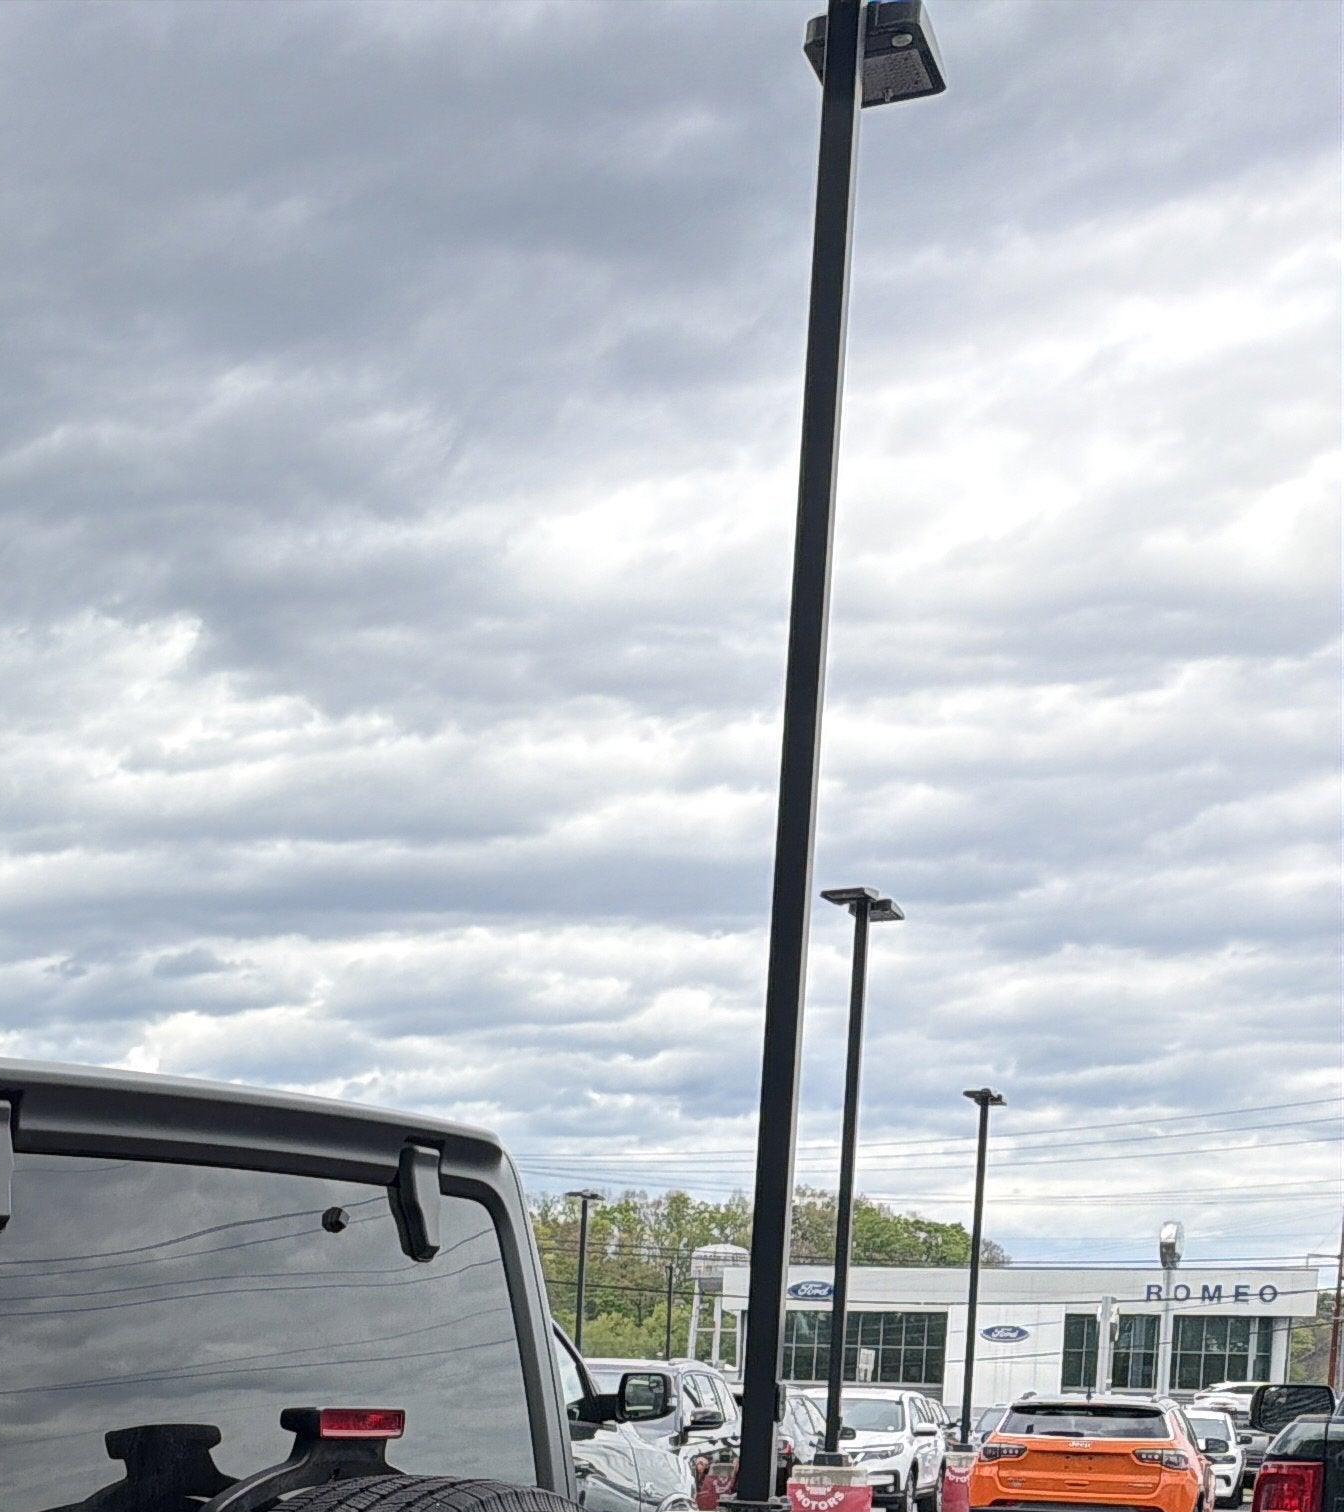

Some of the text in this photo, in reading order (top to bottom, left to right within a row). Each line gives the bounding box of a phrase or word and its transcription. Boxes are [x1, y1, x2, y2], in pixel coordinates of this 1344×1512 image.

[797, 1283, 830, 1296] Ford
[1145, 1284, 1278, 1303] ROMEO
[1067, 1440, 1092, 1449] Jeep
[794, 1488, 845, 1511] MOTORS
